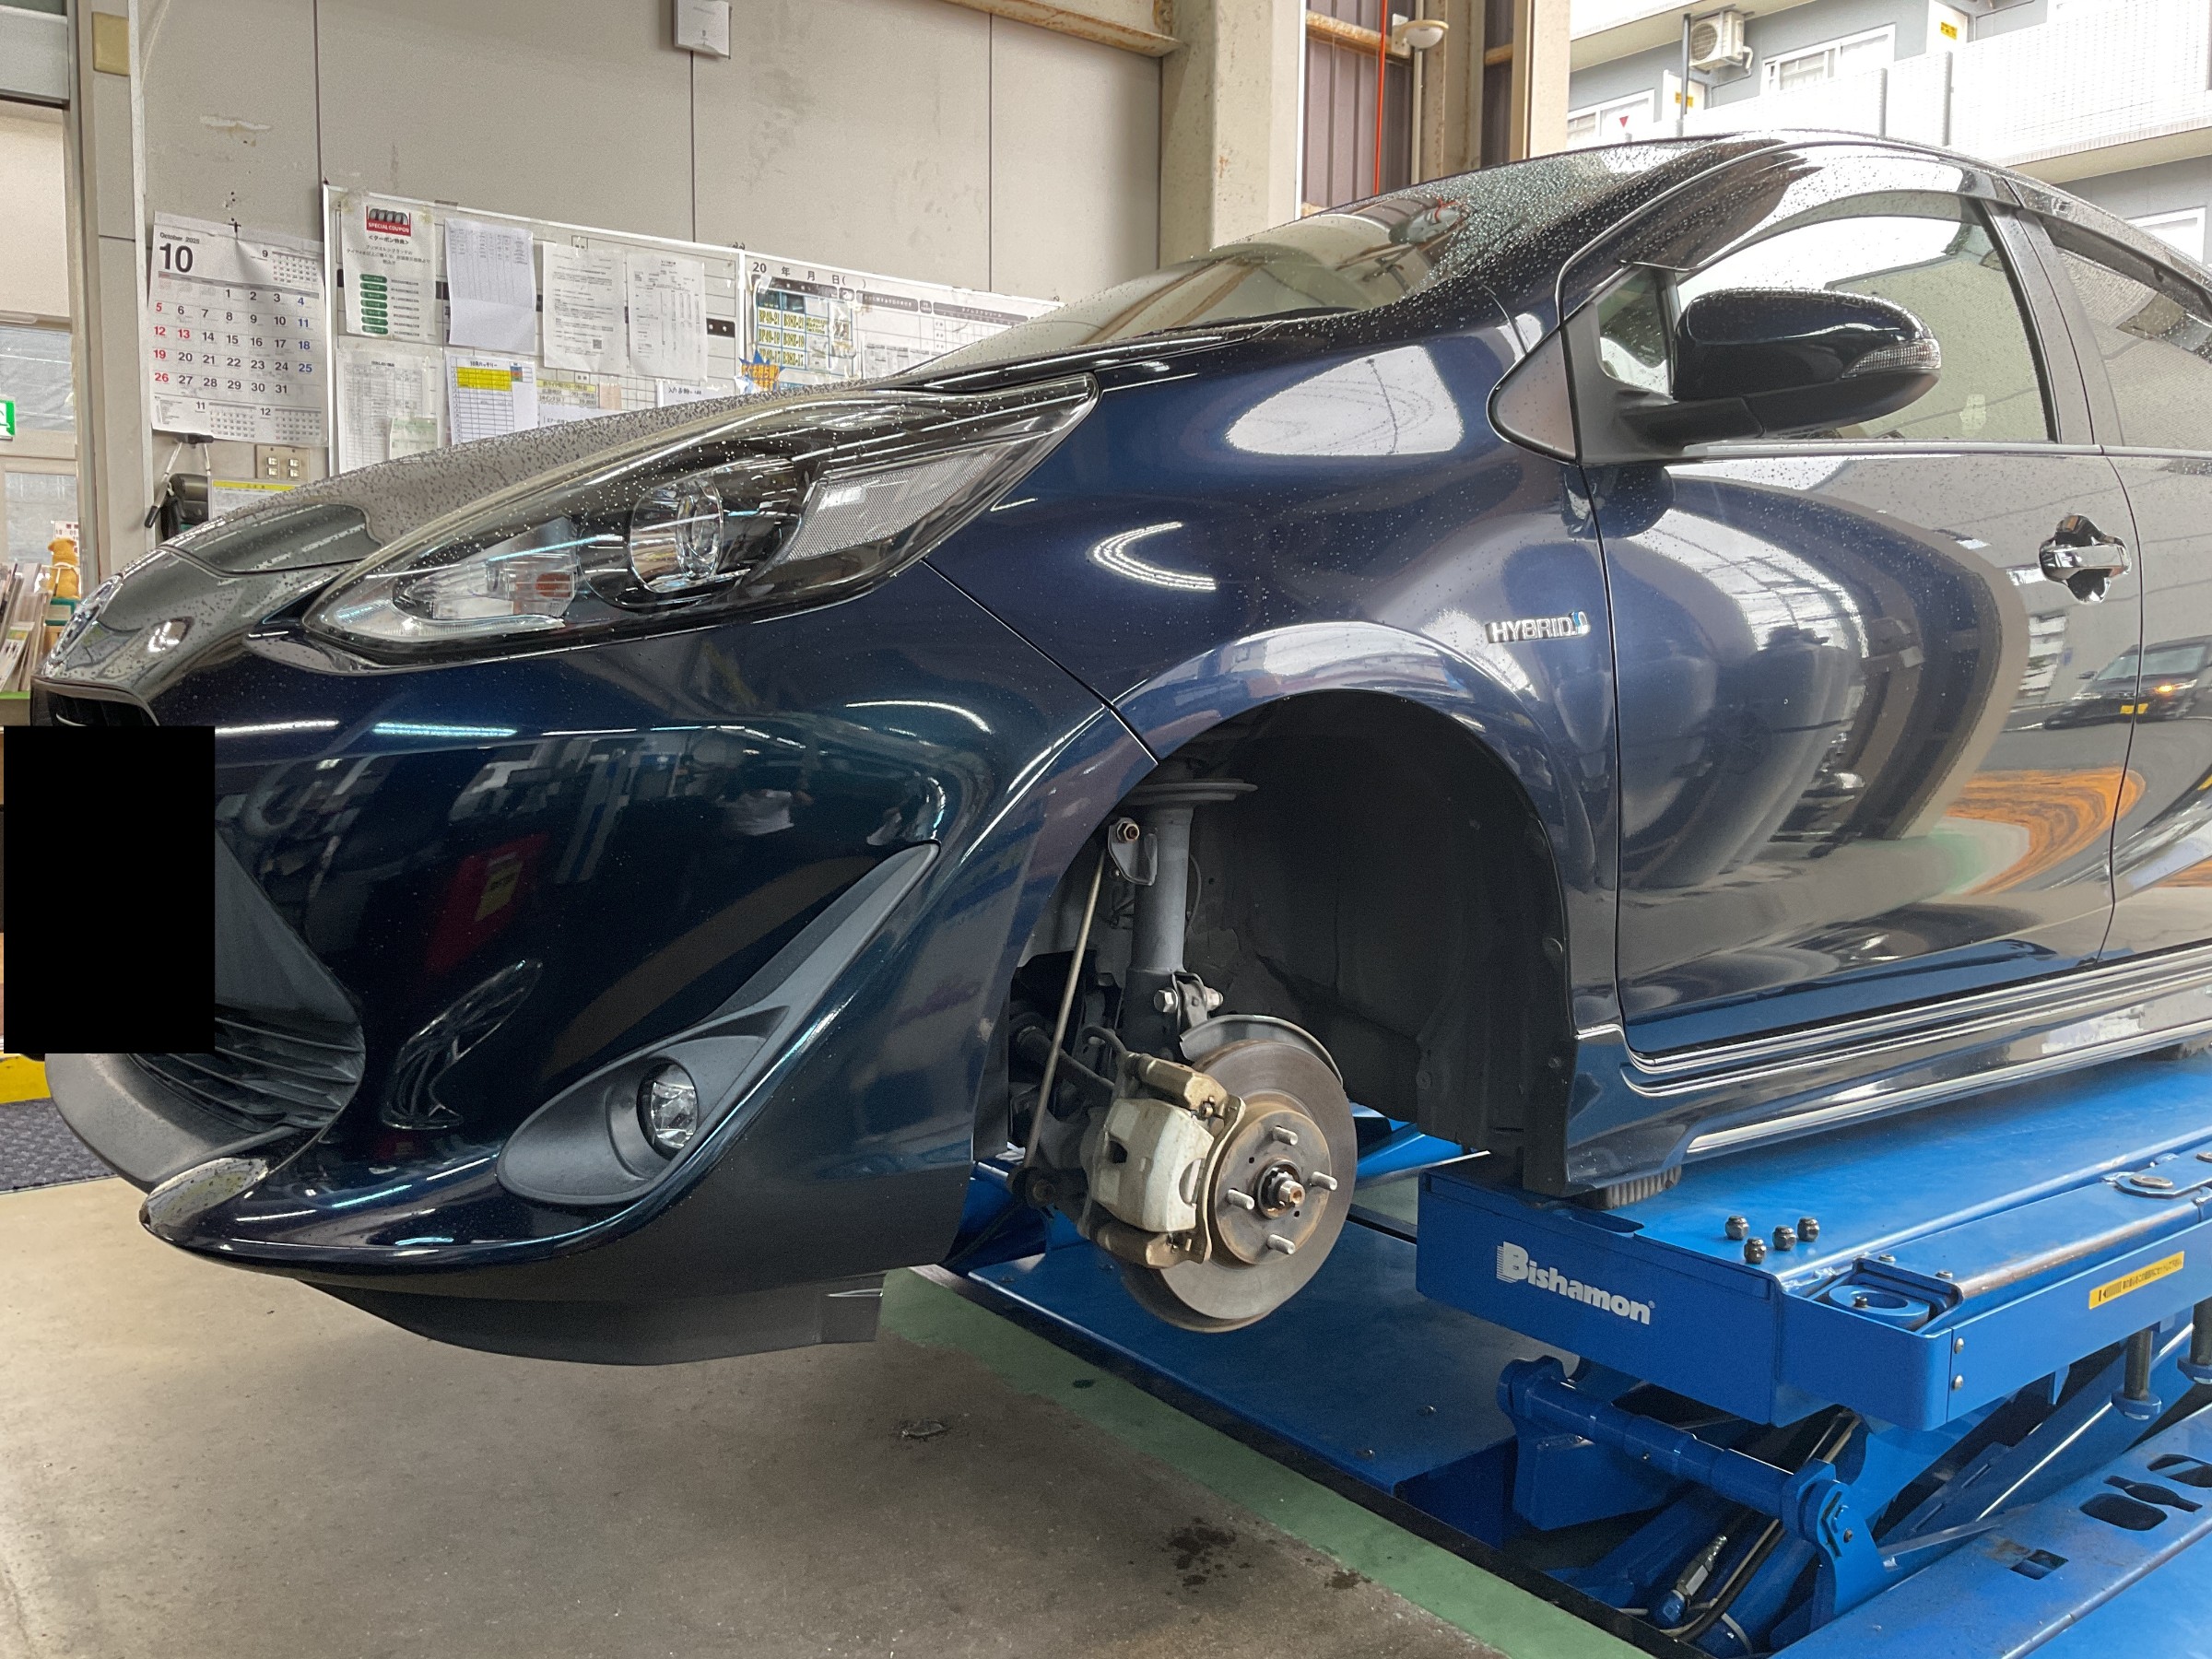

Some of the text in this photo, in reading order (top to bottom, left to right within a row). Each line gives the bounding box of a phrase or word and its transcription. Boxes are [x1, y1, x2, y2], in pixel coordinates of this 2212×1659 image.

[159, 232, 182, 241] October
[368, 222, 409, 233] SPECIAL COUPON
[159, 242, 194, 273] 10
[262, 250, 268, 258] 9
[752, 262, 767, 274] 20
[782, 265, 791, 276] 年
[807, 270, 816, 281] 月
[226, 289, 304, 305] 1 2 3 4
[156, 302, 309, 327] 5 6 7 8 9 10 11
[154, 326, 310, 350] 12 13 14 15 16 17 18
[154, 349, 312, 373] 19 20 21 22 23 24 25
[154, 372, 288, 394] 26 27 28 29 30 31
[196, 401, 271, 416] 11 12
[1486, 616, 1577, 643] HYBRID
[1497, 1241, 1651, 1325] Bishamon
